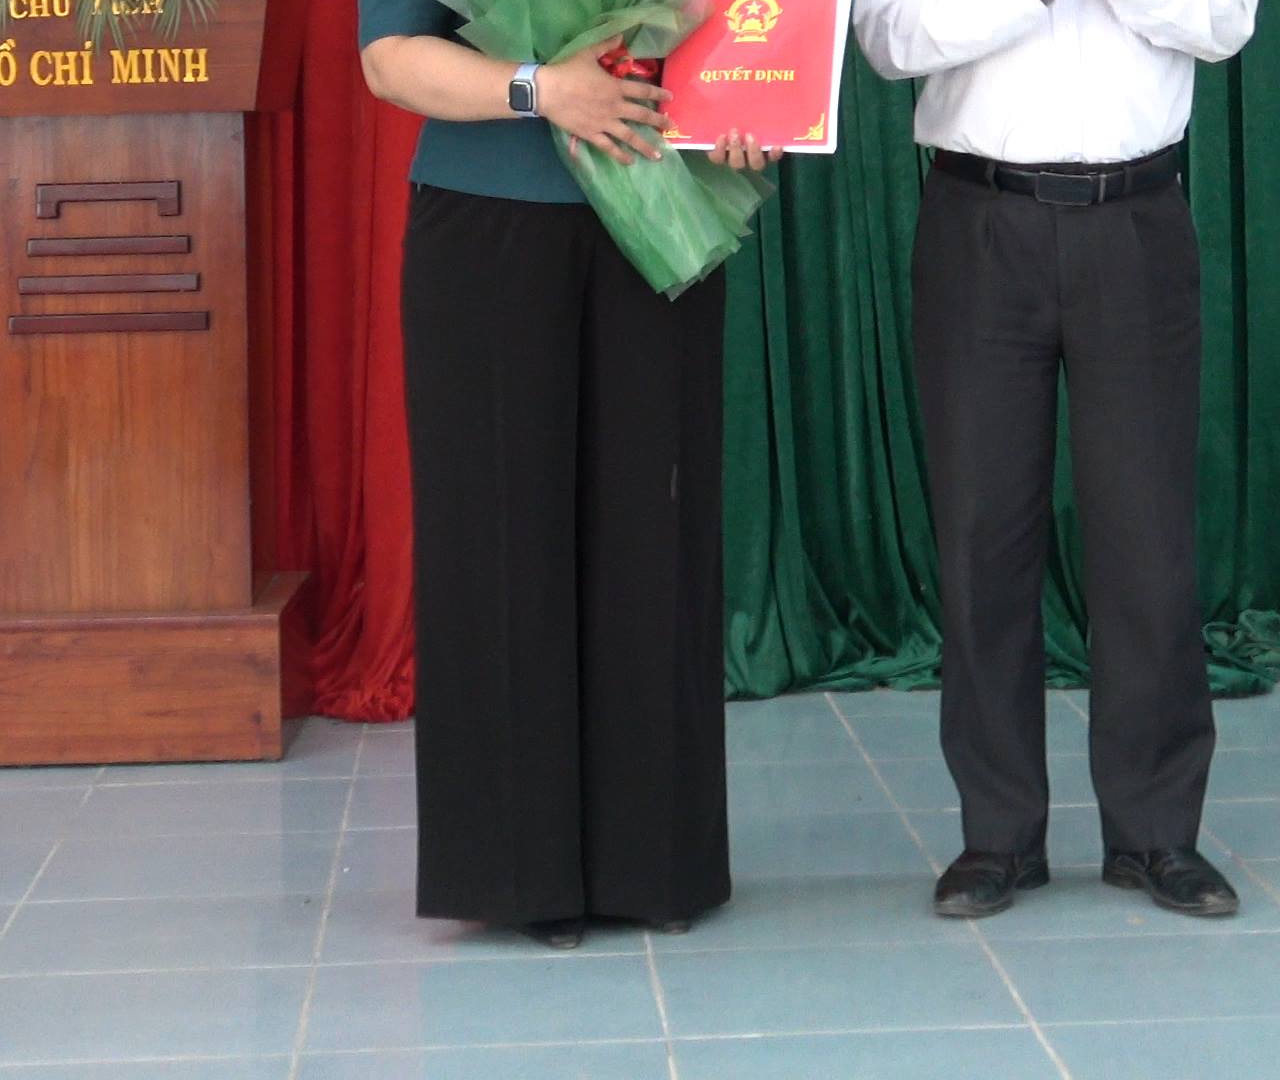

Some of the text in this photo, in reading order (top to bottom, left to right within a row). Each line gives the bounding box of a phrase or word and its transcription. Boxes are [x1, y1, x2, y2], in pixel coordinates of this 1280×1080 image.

[30, 40, 94, 86] CHÍ
[110, 48, 209, 84] MINH
[700, 66, 795, 84] QUYẾT ĐỊNH
